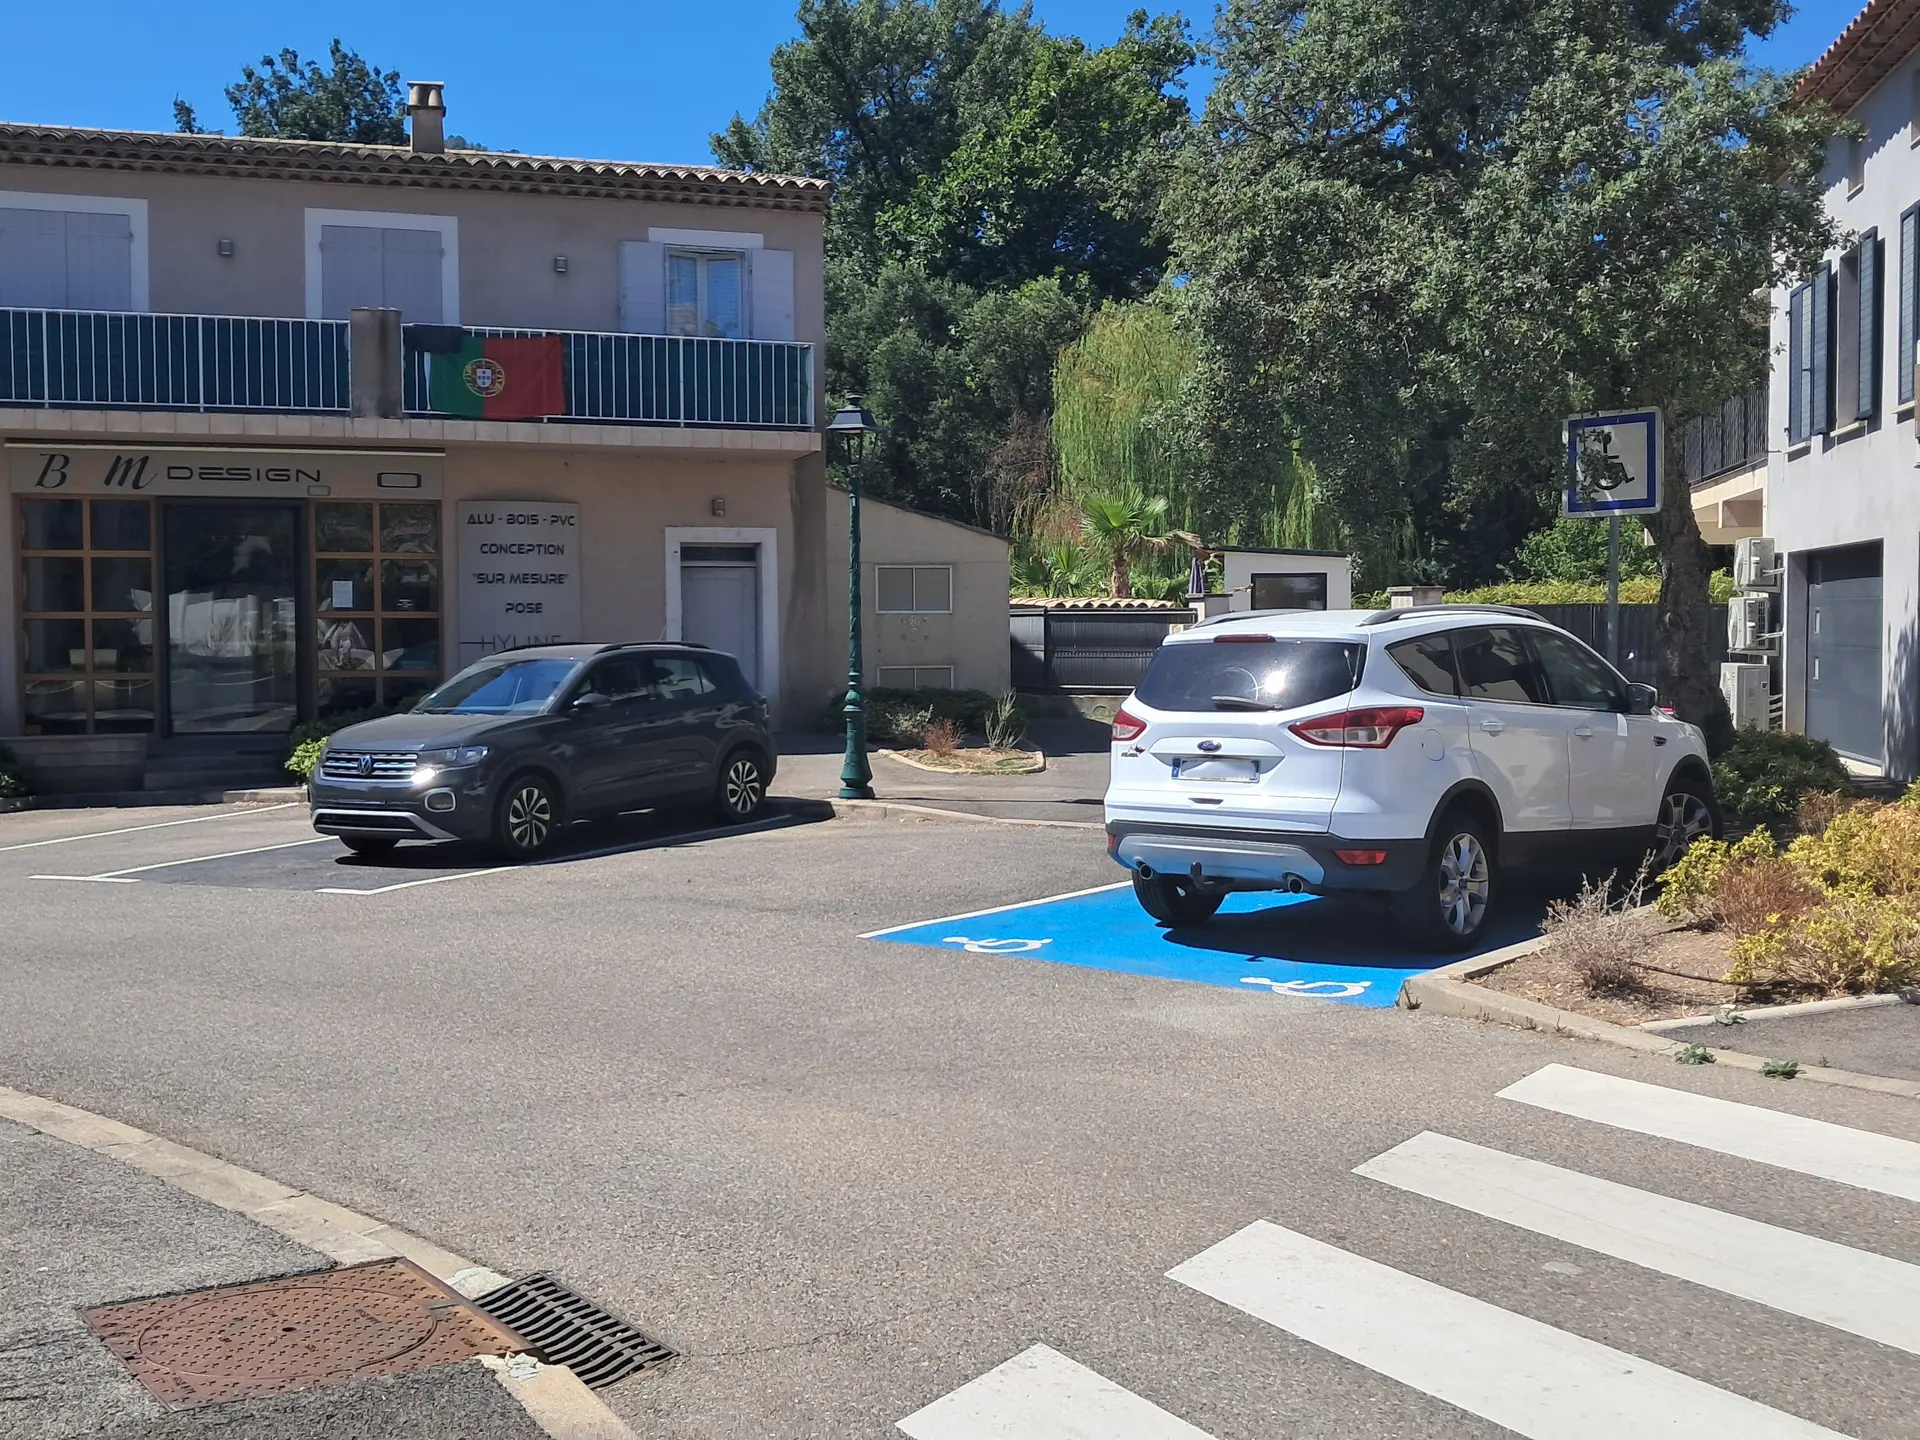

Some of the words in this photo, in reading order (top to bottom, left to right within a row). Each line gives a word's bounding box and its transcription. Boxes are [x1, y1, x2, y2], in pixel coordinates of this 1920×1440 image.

[34, 453, 70, 489] B
[166, 465, 322, 483] DESIGN
[467, 513, 494, 525] ALU
[506, 513, 539, 525] BOIS
[550, 514, 576, 527] PVC
[480, 543, 565, 556] CONCEPTION
[505, 602, 543, 614] POSE
